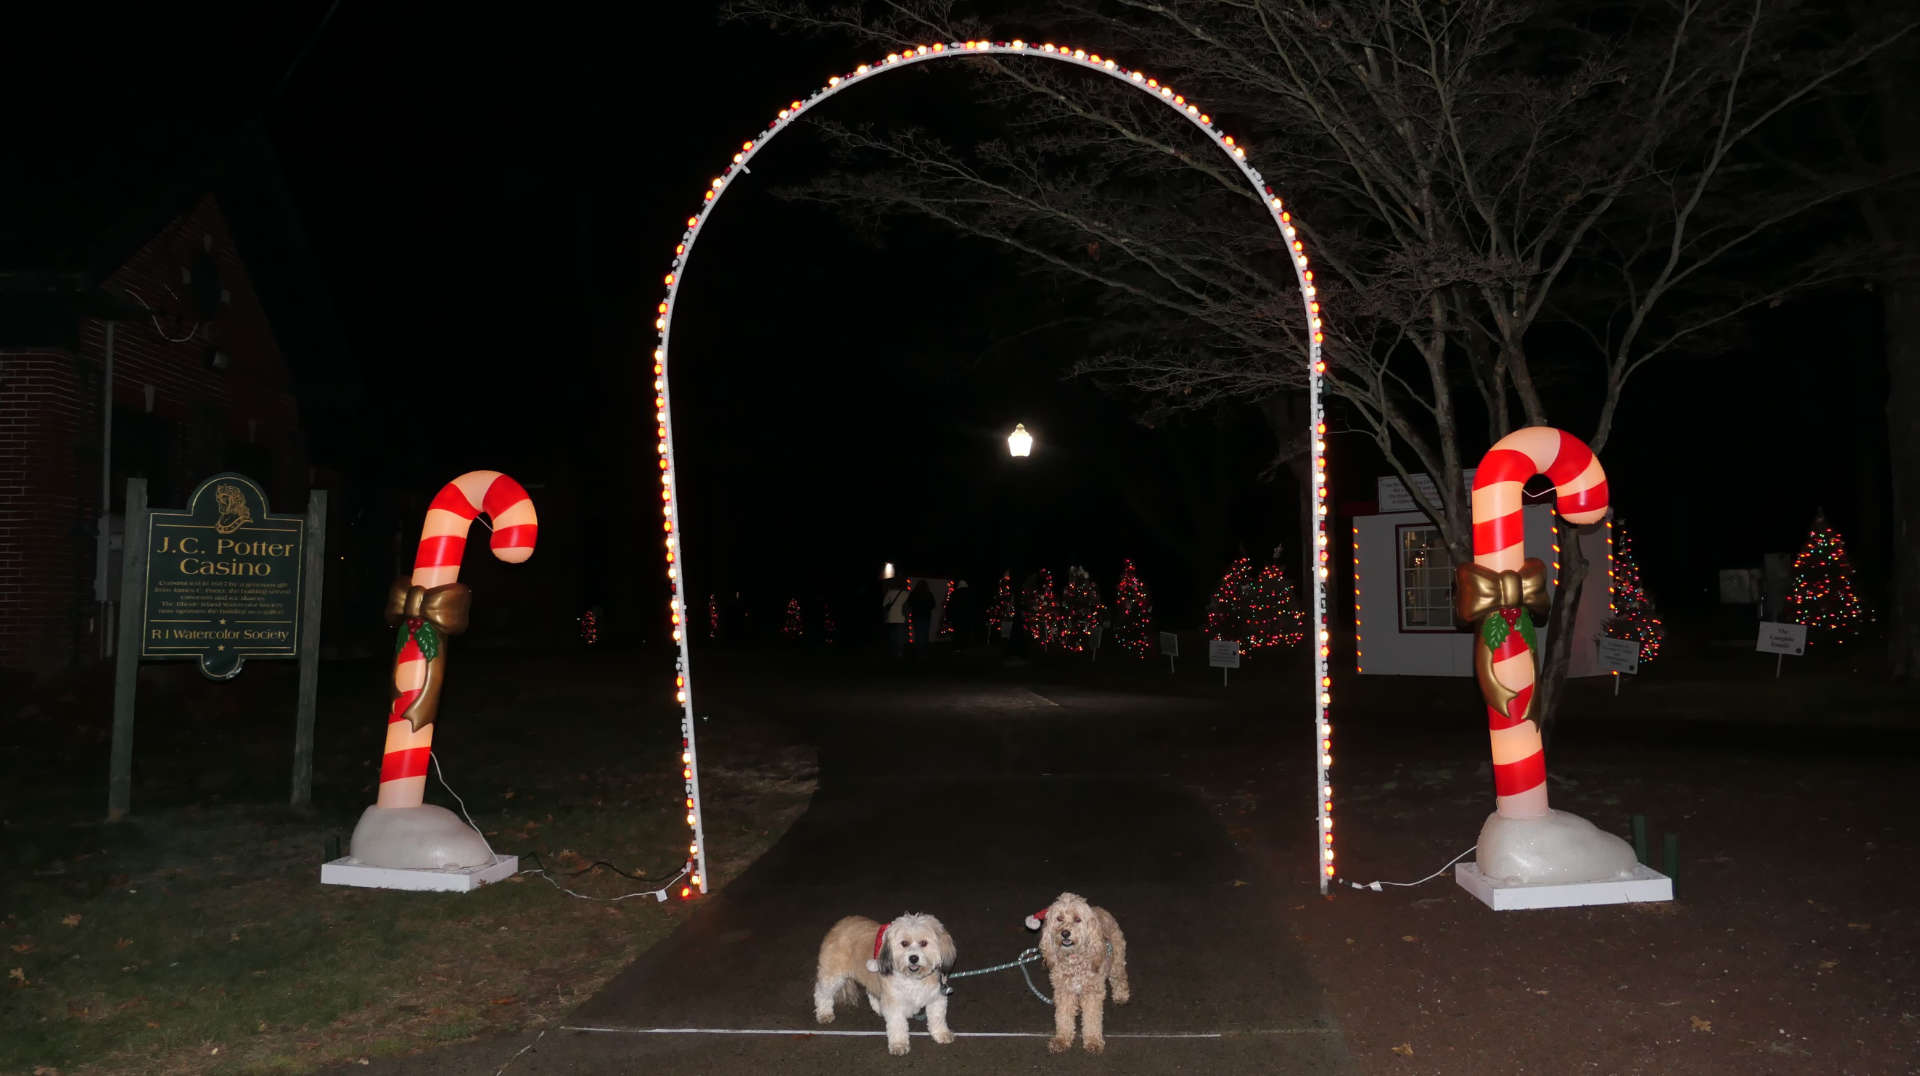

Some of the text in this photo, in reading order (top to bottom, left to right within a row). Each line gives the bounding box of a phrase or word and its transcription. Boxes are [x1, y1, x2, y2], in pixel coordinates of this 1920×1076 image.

[157, 536, 294, 557] J.C. Potter
[179, 557, 272, 576] Casino
[151, 629, 161, 639] R
[173, 629, 240, 640] Watercolor
[243, 629, 289, 641] Society
